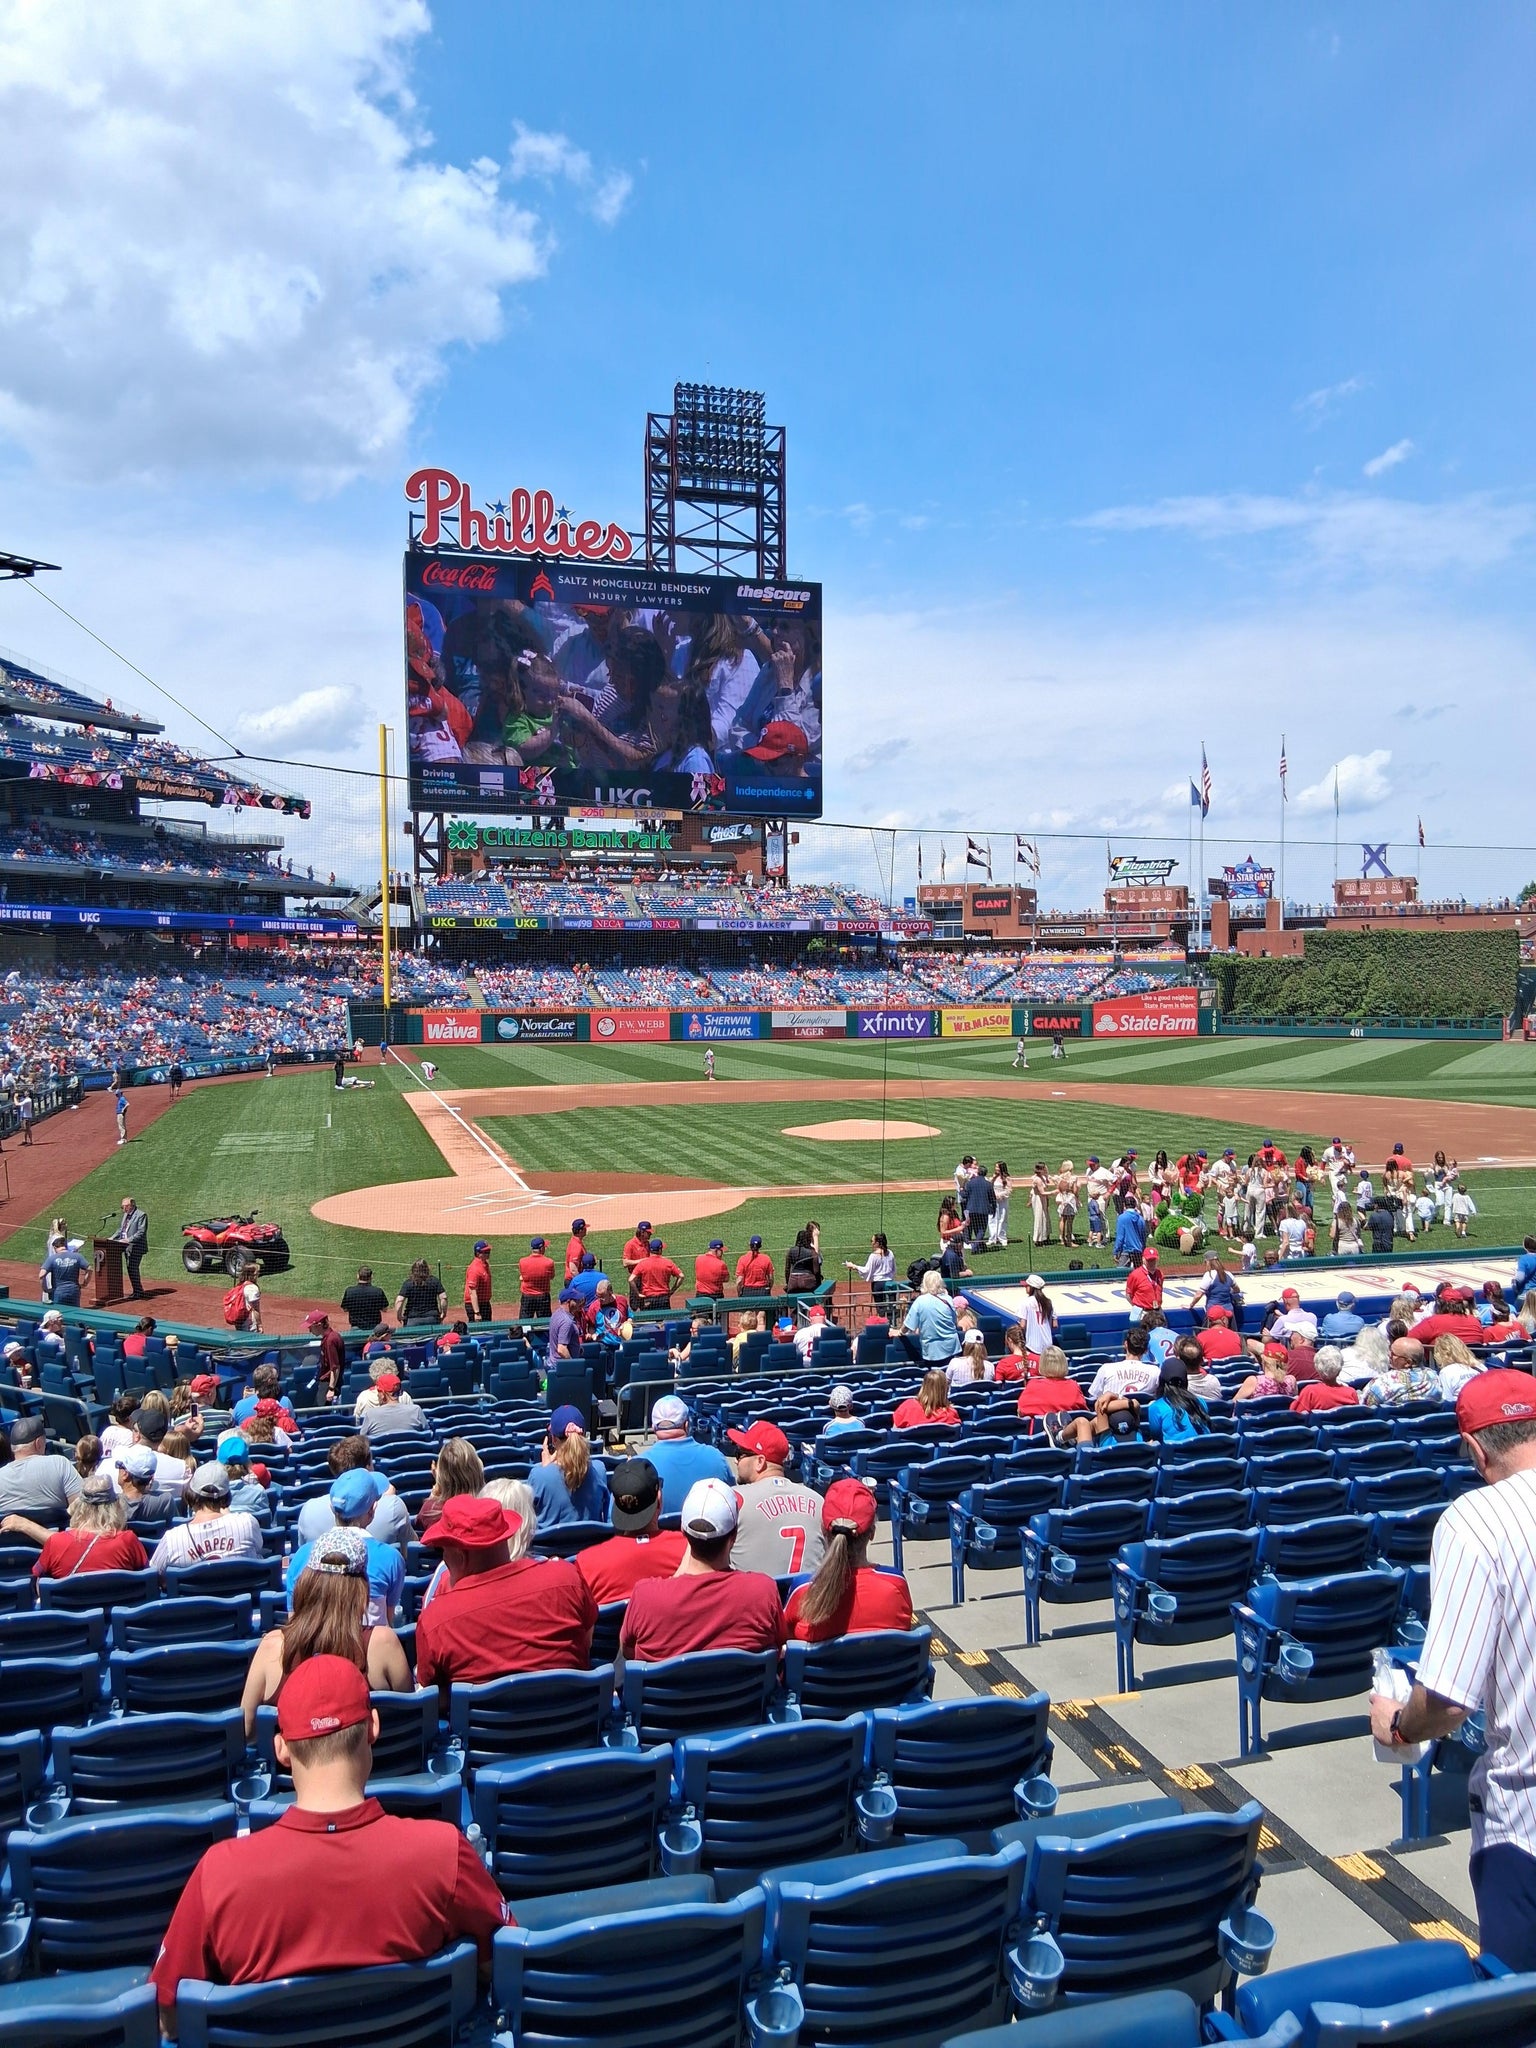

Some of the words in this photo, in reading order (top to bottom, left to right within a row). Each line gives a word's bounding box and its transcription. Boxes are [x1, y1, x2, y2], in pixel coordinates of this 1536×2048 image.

[404, 467, 634, 562] Phillies
[557, 575, 588, 587] SALTZ
[592, 578, 657, 591] MONGELUZZI
[661, 583, 711, 595] BENDESKY
[588, 592, 627, 602] INJURY
[635, 595, 682, 606] LAWYERS
[736, 585, 811, 602] theScore
[422, 769, 456, 780] Driving
[595, 786, 653, 808] UKG
[735, 786, 803, 798] Independence
[482, 826, 568, 847] Citizens
[572, 828, 625, 849] Bank
[627, 829, 673, 849] Park
[710, 823, 745, 842] GHOST
[1119, 857, 1172, 872] Fitzpatrick
[1236, 872, 1254, 882] STAR
[1254, 871, 1274, 881] GAME
[975, 899, 1008, 909] GIANT
[79, 912, 101, 923] UKG
[432, 917, 457, 927] UKG
[474, 918, 498, 928] UKG
[515, 918, 539, 928] UKG
[595, 920, 621, 928] NECA
[342, 924, 357, 933] UKG
[716, 920, 754, 929] LISCIO'S
[756, 920, 792, 929] BAKERY
[841, 921, 876, 930] TOYOTA
[895, 922, 930, 930] TOYOTA
[520, 1018, 575, 1031] NovaCare
[638, 1020, 665, 1028] WEBB
[703, 1014, 751, 1026] SHERWIN
[786, 1012, 832, 1026] Yuengling
[862, 1012, 927, 1034] xfinity
[1033, 1017, 1081, 1030] GIANT
[427, 1023, 478, 1040] Wawa
[794, 1027, 824, 1036] LAGER
[1350, 1028, 1364, 1037] 401
[1117, 1369, 1150, 1385] HARPER
[756, 1494, 817, 1522] TURNER
[187, 1537, 235, 1561] HARPER
[779, 1525, 807, 1574] 7
[310, 1717, 341, 1731] Phillies
